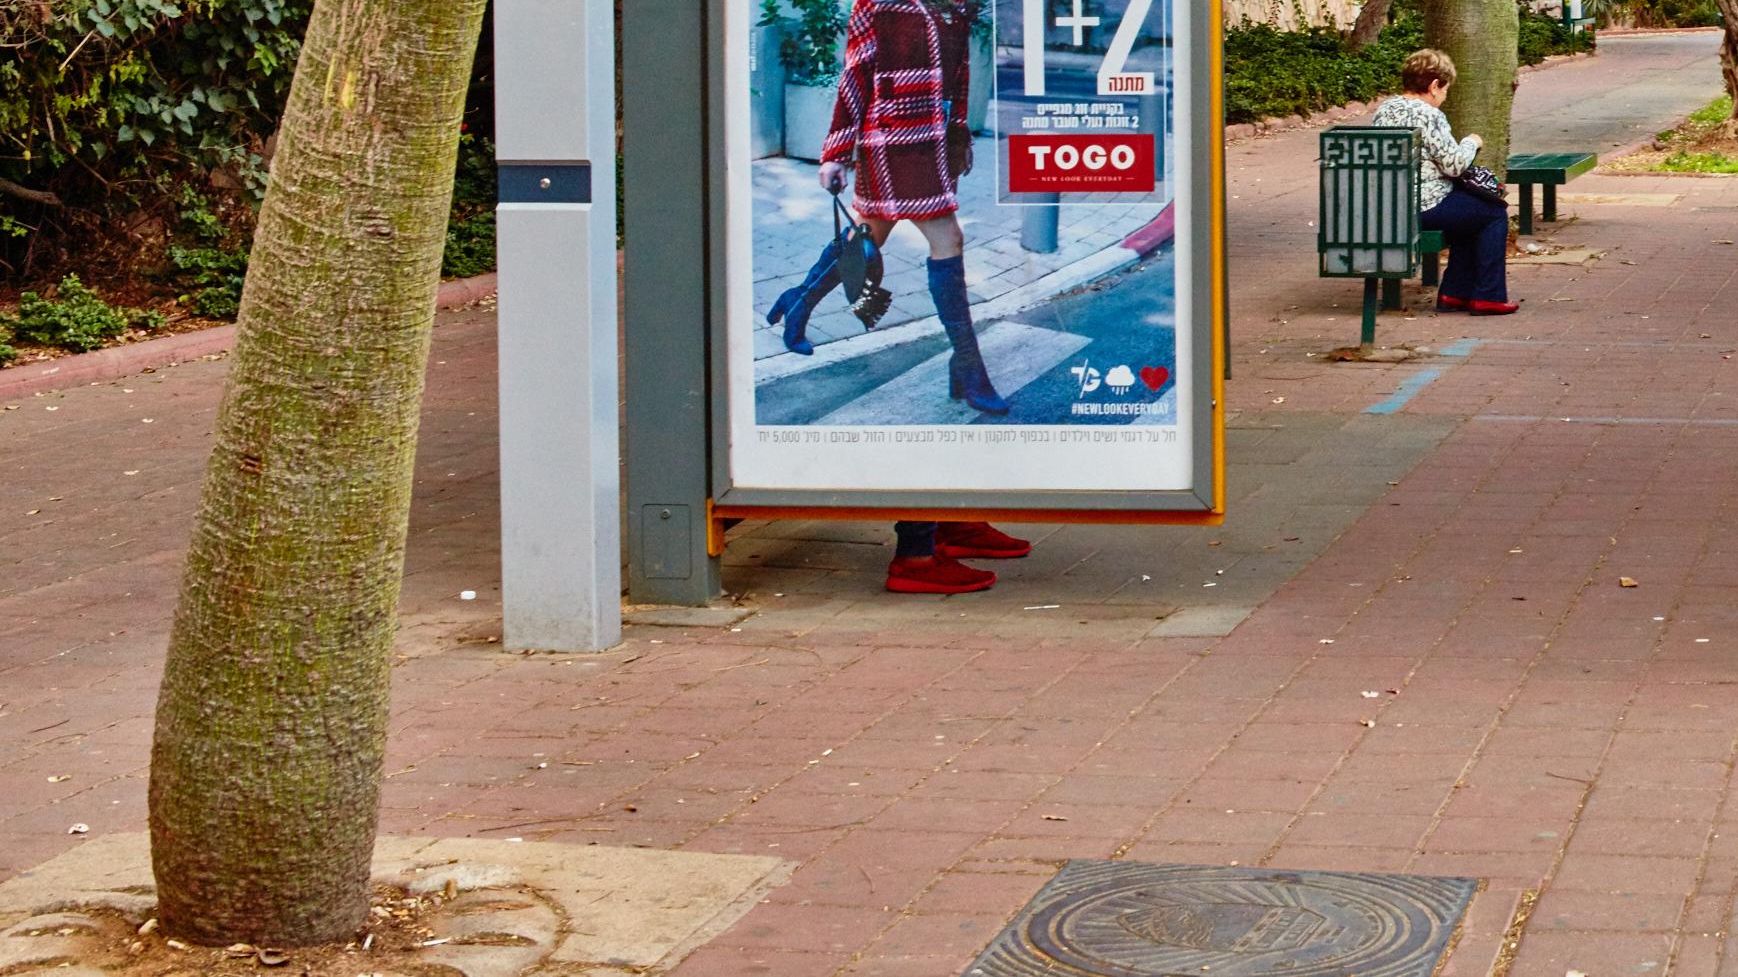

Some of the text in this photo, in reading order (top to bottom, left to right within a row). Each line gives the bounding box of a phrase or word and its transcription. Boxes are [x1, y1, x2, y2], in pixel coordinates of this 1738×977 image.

[1108, 77, 1144, 92] מתנה
[1027, 144, 1135, 170] TOGO
[1071, 402, 1170, 416] #NEWLOOKEVERYDAY
[773, 430, 800, 444] 5,000
